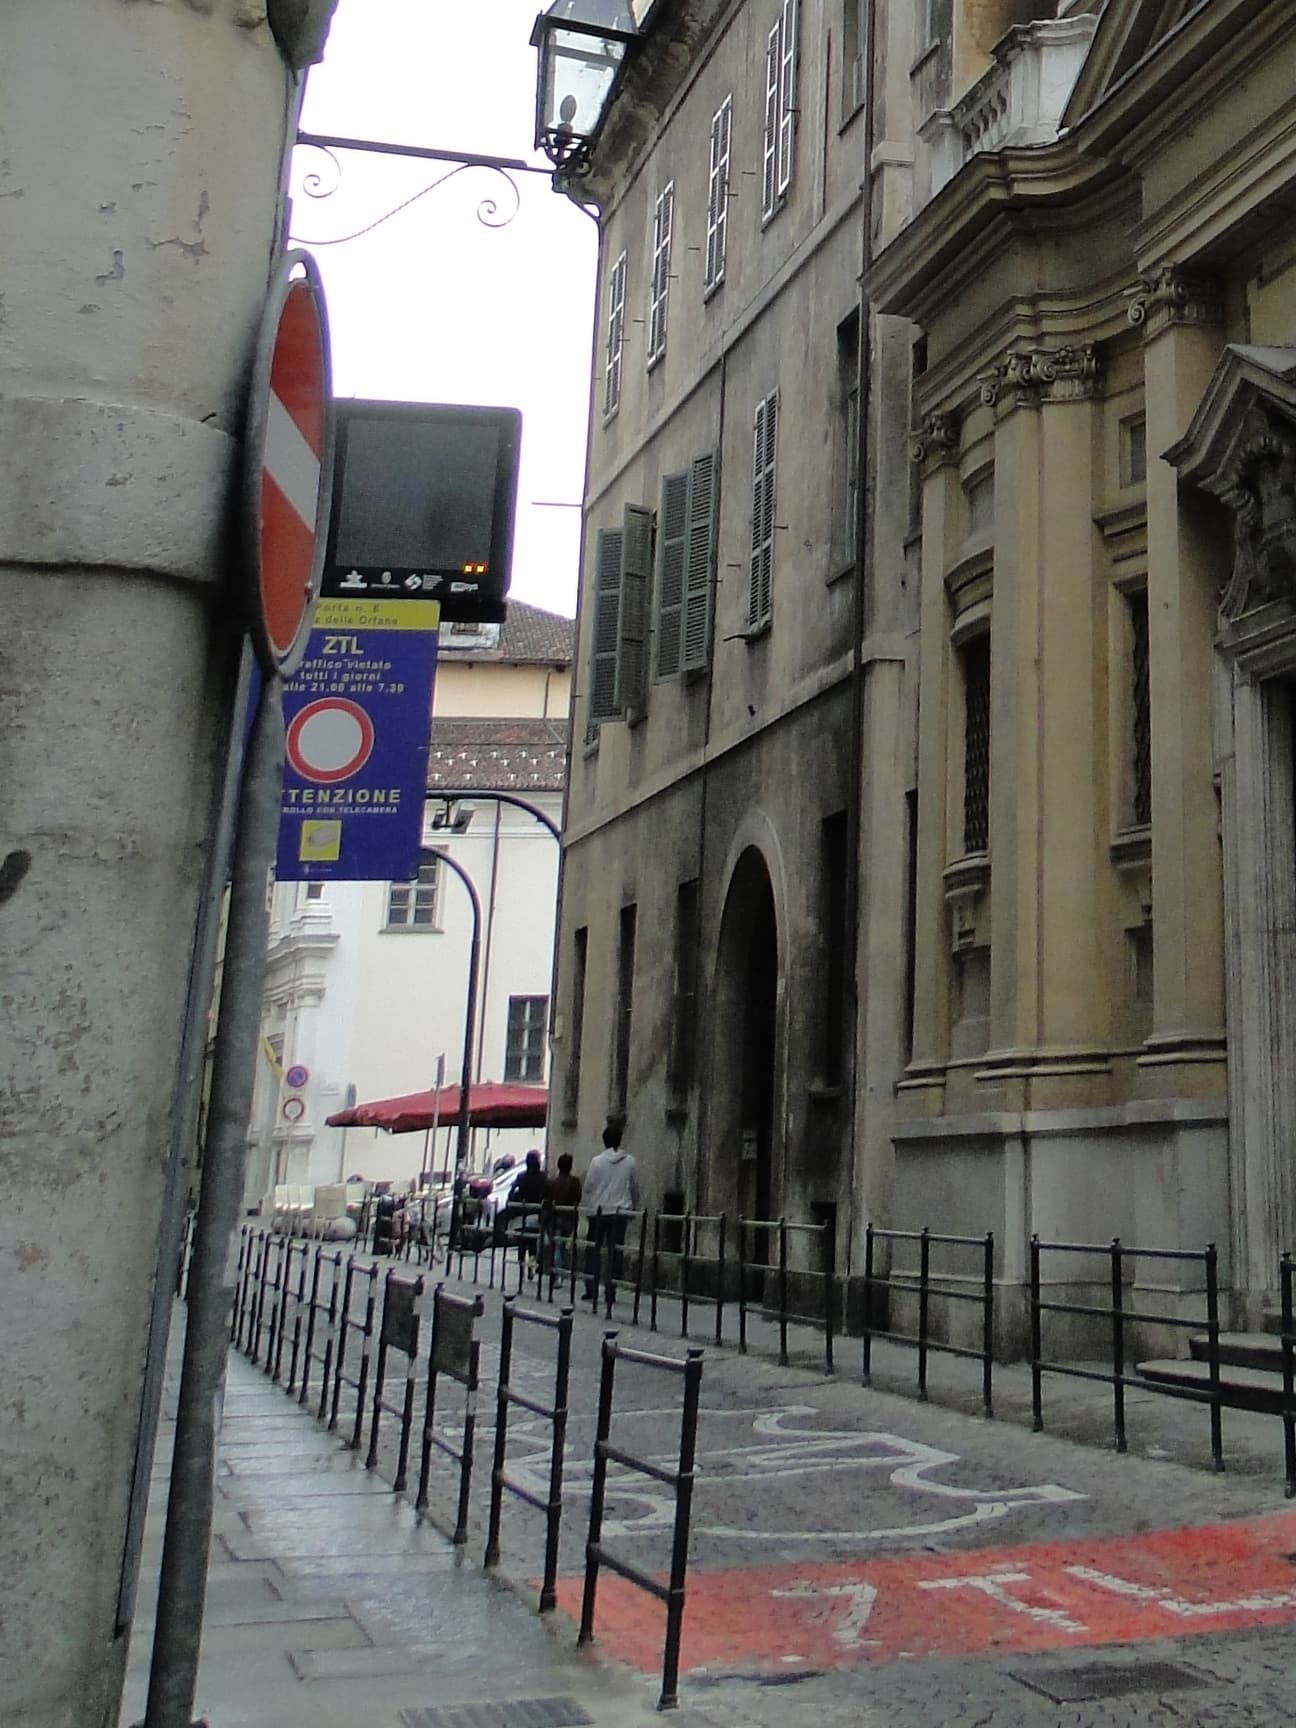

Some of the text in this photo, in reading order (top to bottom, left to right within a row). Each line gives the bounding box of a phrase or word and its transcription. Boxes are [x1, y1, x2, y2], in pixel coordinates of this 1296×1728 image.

[325, 615, 353, 624] delle
[359, 615, 399, 625] Orfane
[322, 636, 364, 654] ZTL
[299, 660, 391, 670] raffico vietato
[300, 671, 328, 680] tutti
[342, 672, 380, 681] giorni
[283, 683, 305, 692] alle
[350, 684, 373, 692] alle
[378, 683, 404, 692] 7.30
[280, 789, 401, 804] TENZIONE
[283, 806, 314, 814] ROLLO
[339, 806, 398, 814] TELECAMERA
